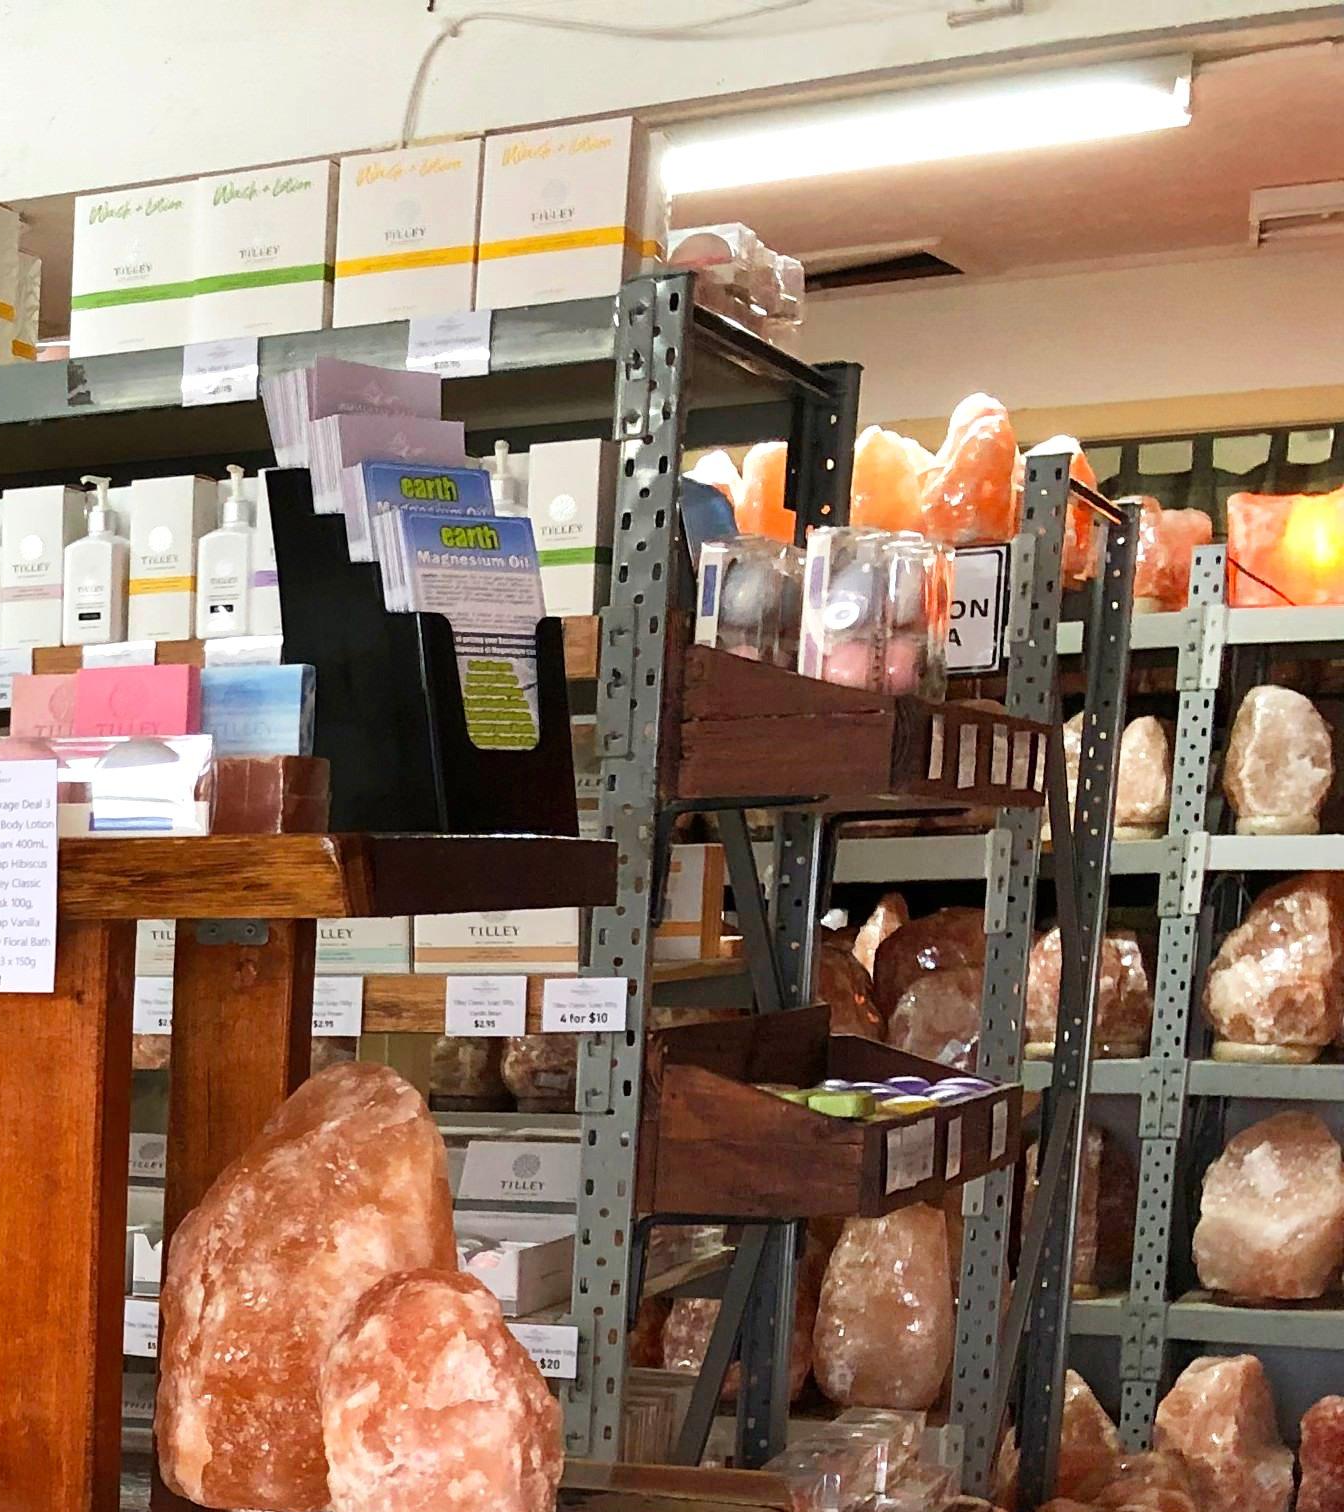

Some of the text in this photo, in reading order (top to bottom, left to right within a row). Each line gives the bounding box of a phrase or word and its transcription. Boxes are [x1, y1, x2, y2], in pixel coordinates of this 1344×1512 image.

[399, 475, 458, 501] earth
[541, 523, 584, 536] TILLEY
[439, 525, 501, 550] earth
[141, 554, 179, 566] TILLEY
[417, 550, 531, 569] Magnesium Oil
[12, 562, 50, 574] TILLEY
[22, 799, 42, 809] Deal
[46, 799, 50, 808] 3
[1, 820, 24, 831] Body
[26, 820, 54, 829] Lotion
[11, 859, 47, 869] Hibiscus
[12, 879, 40, 888] Classic
[11, 917, 40, 927] Vanilla
[468, 926, 520, 937] TILLEY
[4, 937, 28, 946] Floral
[31, 937, 51, 946] Bath
[0, 956, 5, 965] 3
[15, 956, 36, 967] 150g
[560, 1012, 608, 1024] 4 for $10
[313, 1020, 334, 1028] $2.95
[474, 1020, 495, 1029] $2.95
[499, 1180, 547, 1191] TILLEY
[539, 1357, 561, 1371] $20
